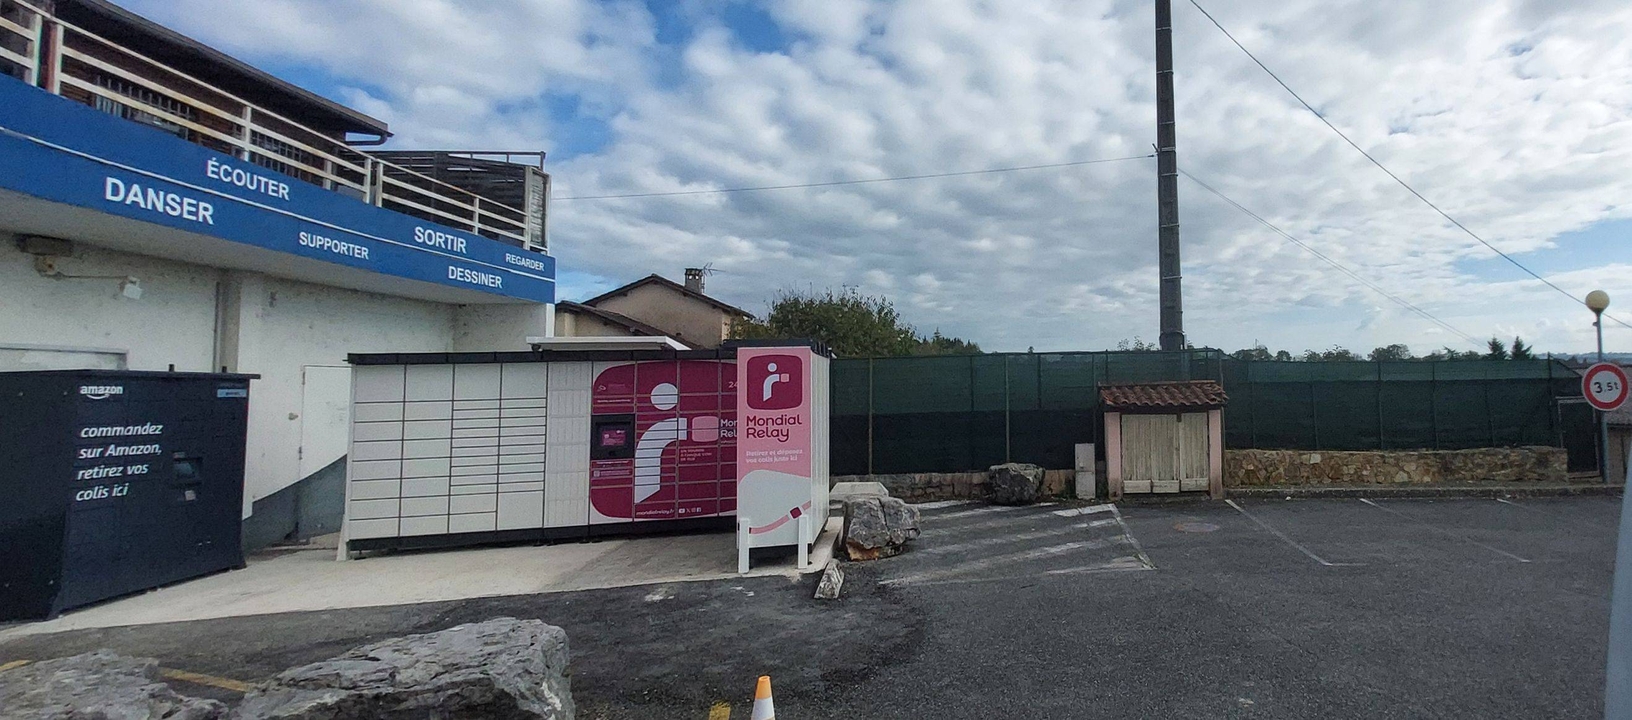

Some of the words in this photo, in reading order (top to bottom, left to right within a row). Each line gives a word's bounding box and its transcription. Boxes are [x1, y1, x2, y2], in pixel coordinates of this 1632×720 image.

[207, 157, 290, 201] ÉCOUTER
[105, 176, 214, 225] DANSER
[299, 231, 369, 260] SUPPORTER
[414, 226, 467, 254] SORTIR
[505, 252, 545, 272] REGARDER
[448, 265, 503, 289] DESSINER
[80, 384, 124, 396] amazon
[80, 421, 164, 439] commandez
[746, 414, 803, 427] Mondial
[720, 429, 738, 438] Rel
[746, 426, 790, 443] Relay
[78, 446, 103, 460] sur
[104, 443, 163, 458] Amazon,
[76, 464, 124, 481] retirez
[127, 462, 149, 476] vos
[75, 485, 109, 502] colis
[112, 482, 129, 497] ici
